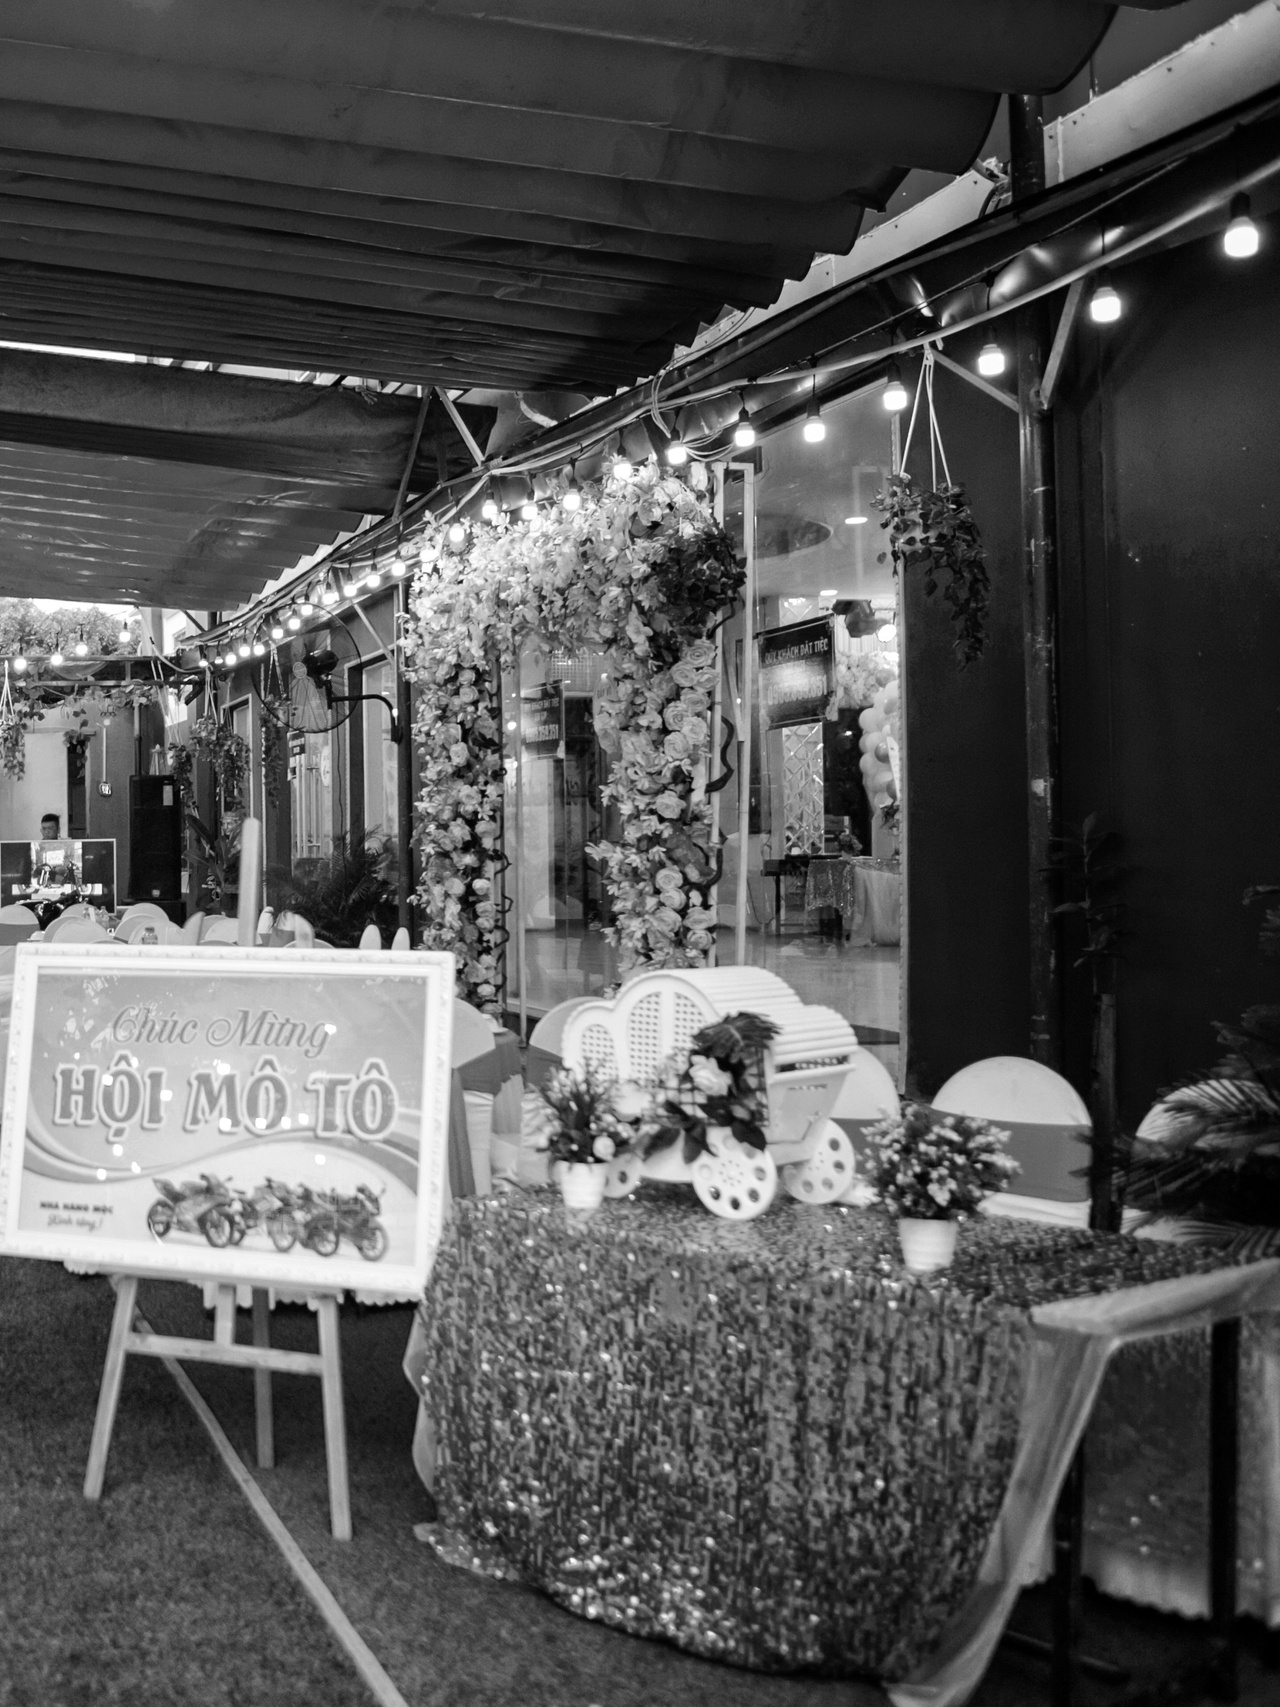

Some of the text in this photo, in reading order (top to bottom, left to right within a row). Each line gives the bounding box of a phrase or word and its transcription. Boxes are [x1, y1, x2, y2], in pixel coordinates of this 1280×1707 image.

[113, 1006, 333, 1059] Chúc Mừng
[55, 1050, 400, 1143] HỘI MÔ TÔ
